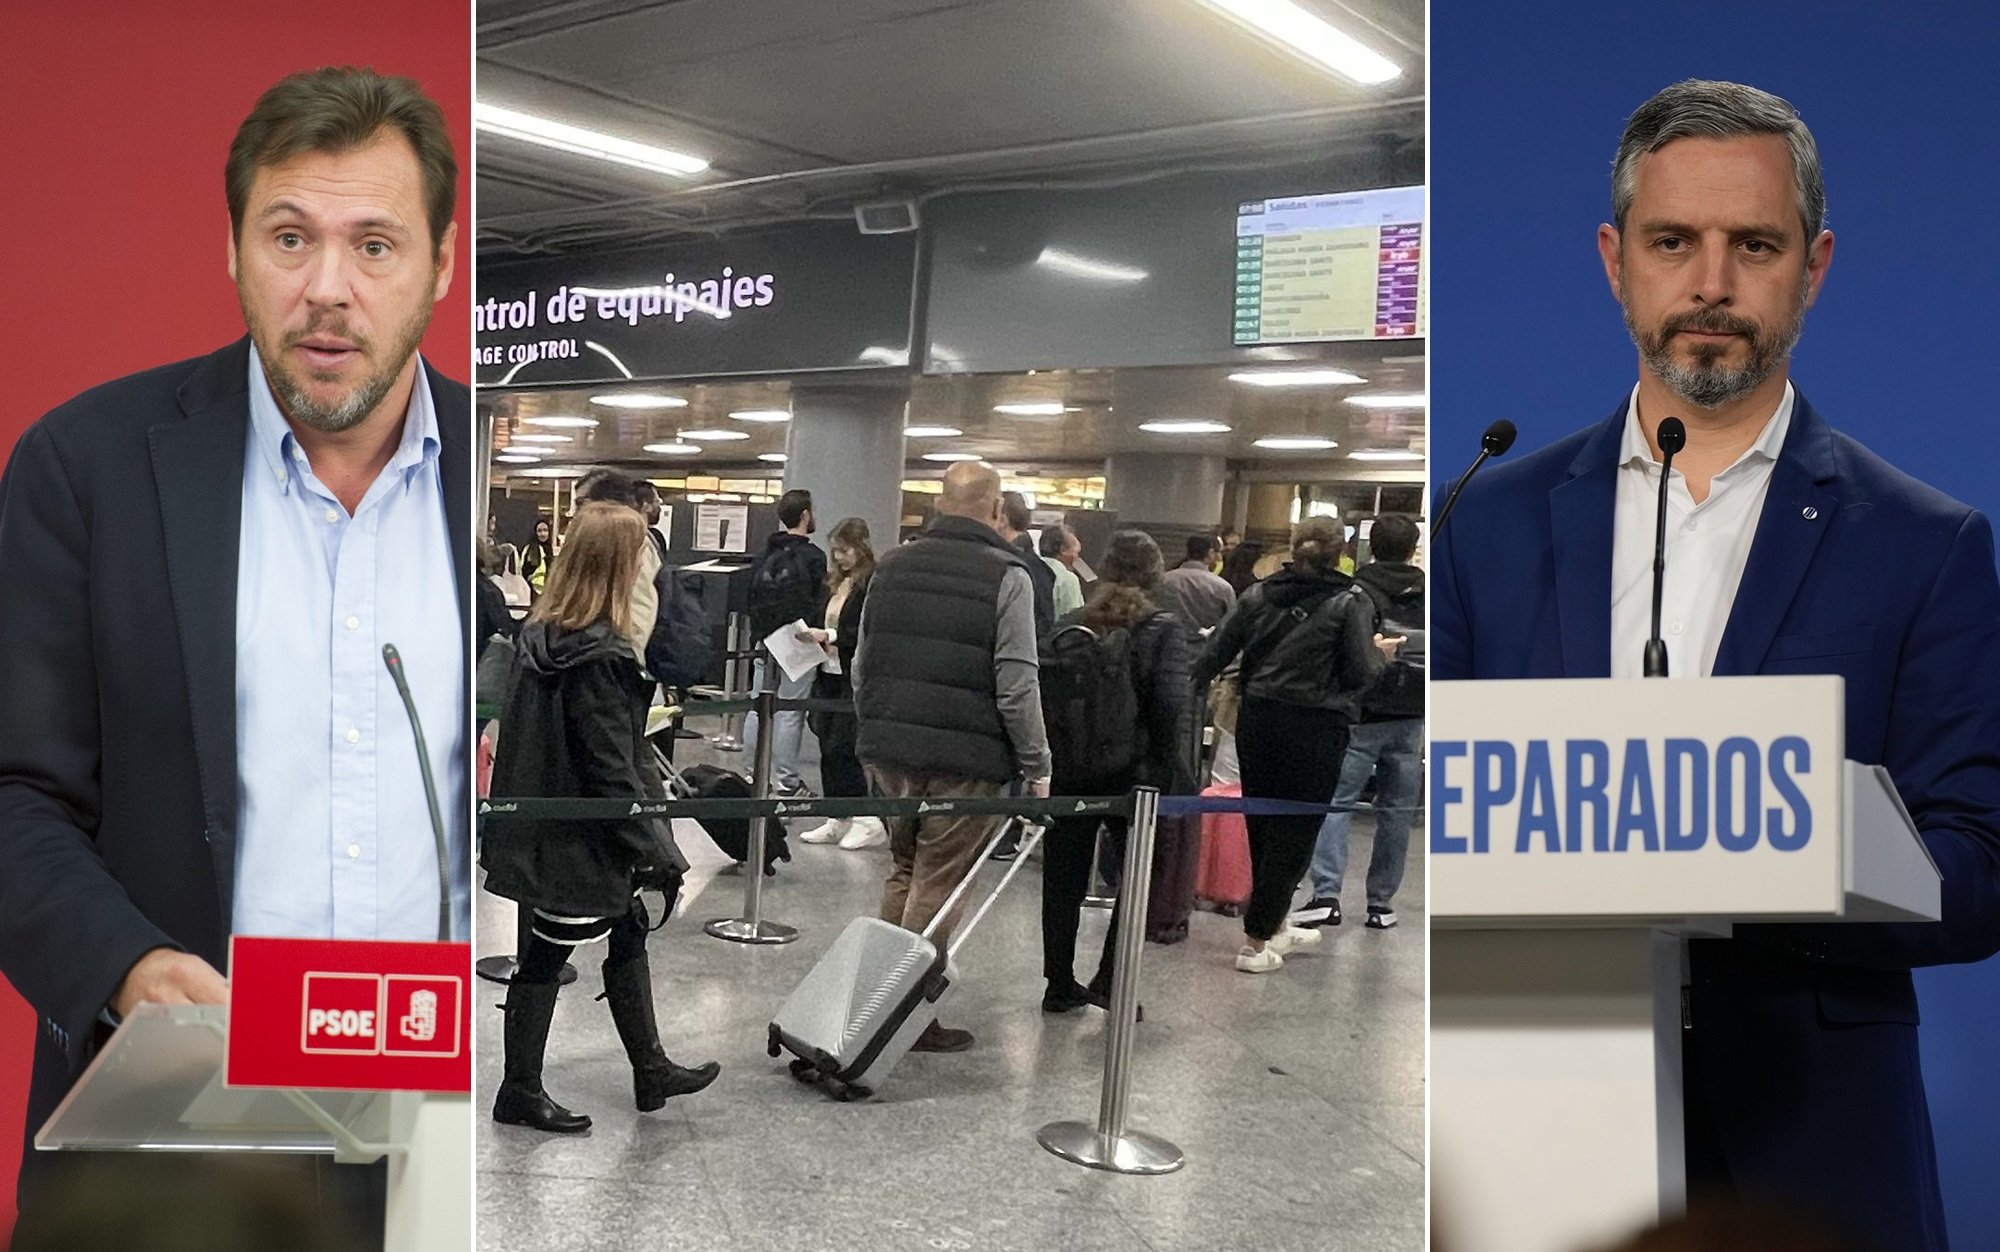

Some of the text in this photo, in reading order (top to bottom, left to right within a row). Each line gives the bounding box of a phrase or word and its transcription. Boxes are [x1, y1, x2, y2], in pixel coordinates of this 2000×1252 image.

[547, 285, 587, 324] de
[597, 266, 774, 326] equipajes
[508, 338, 580, 364] CONTROL
[1430, 735, 1812, 853] EPARADOS
[308, 1008, 376, 1038] PSOE
